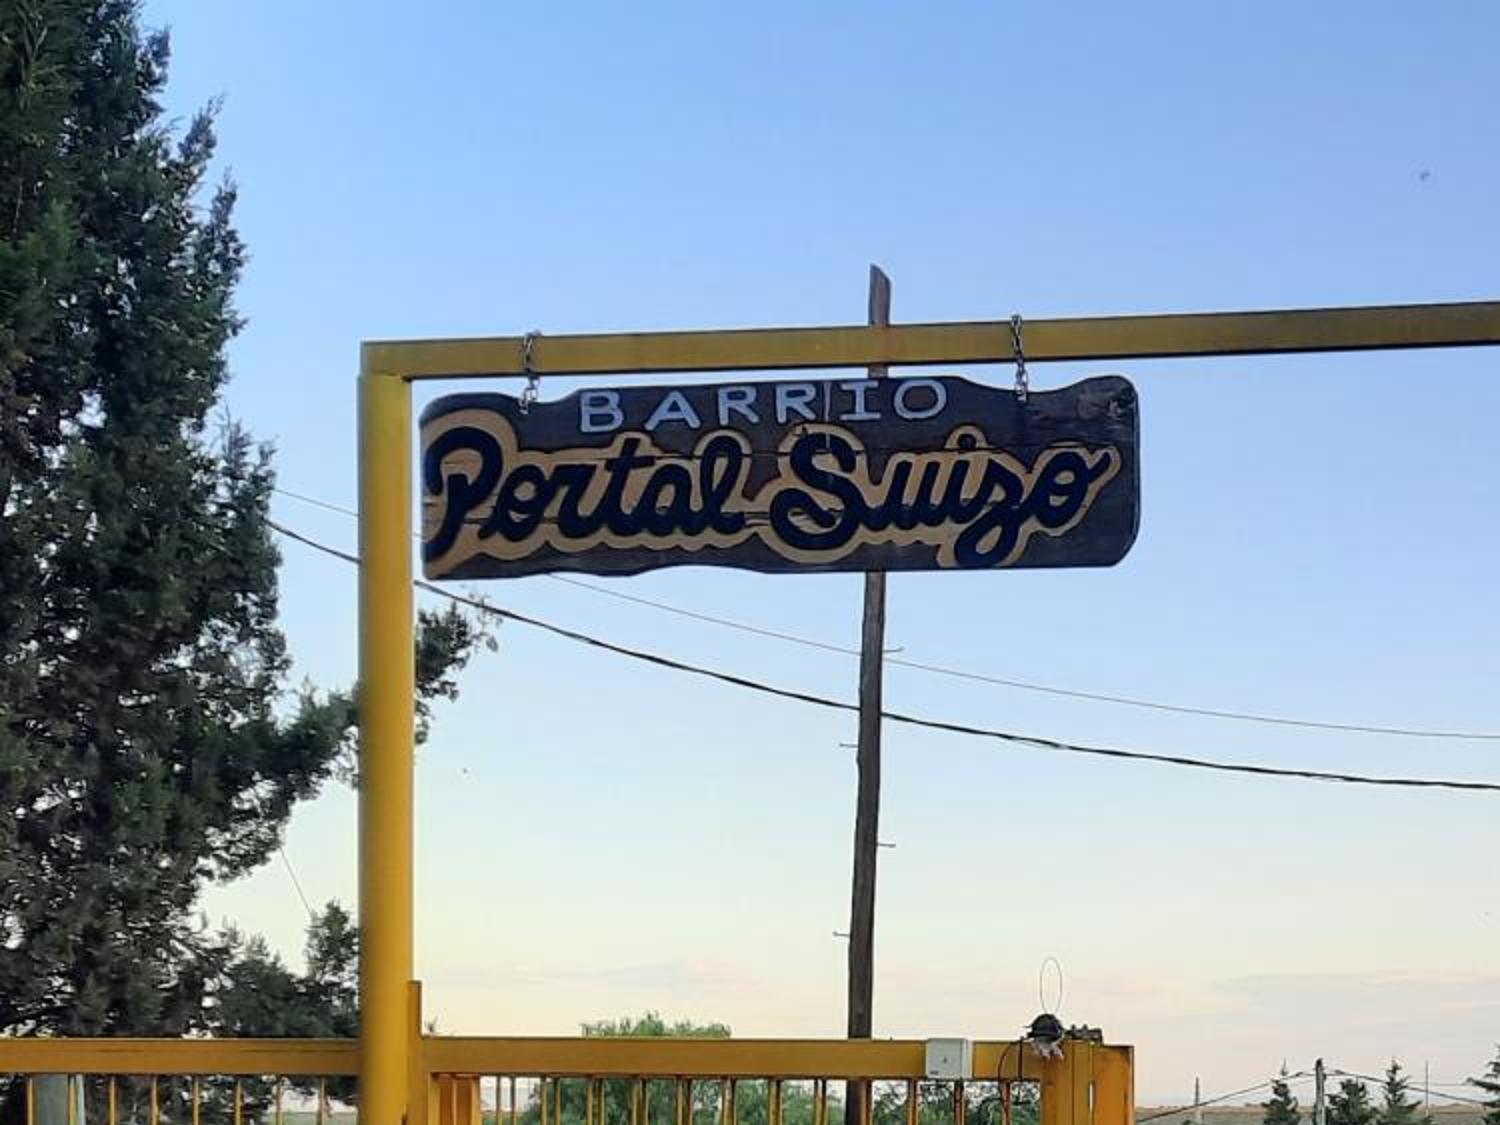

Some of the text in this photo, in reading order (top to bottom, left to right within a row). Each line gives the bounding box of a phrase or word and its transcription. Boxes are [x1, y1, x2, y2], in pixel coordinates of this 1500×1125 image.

[580, 379, 948, 433] BARRIO
[421, 424, 1114, 568] Portal Suizo
